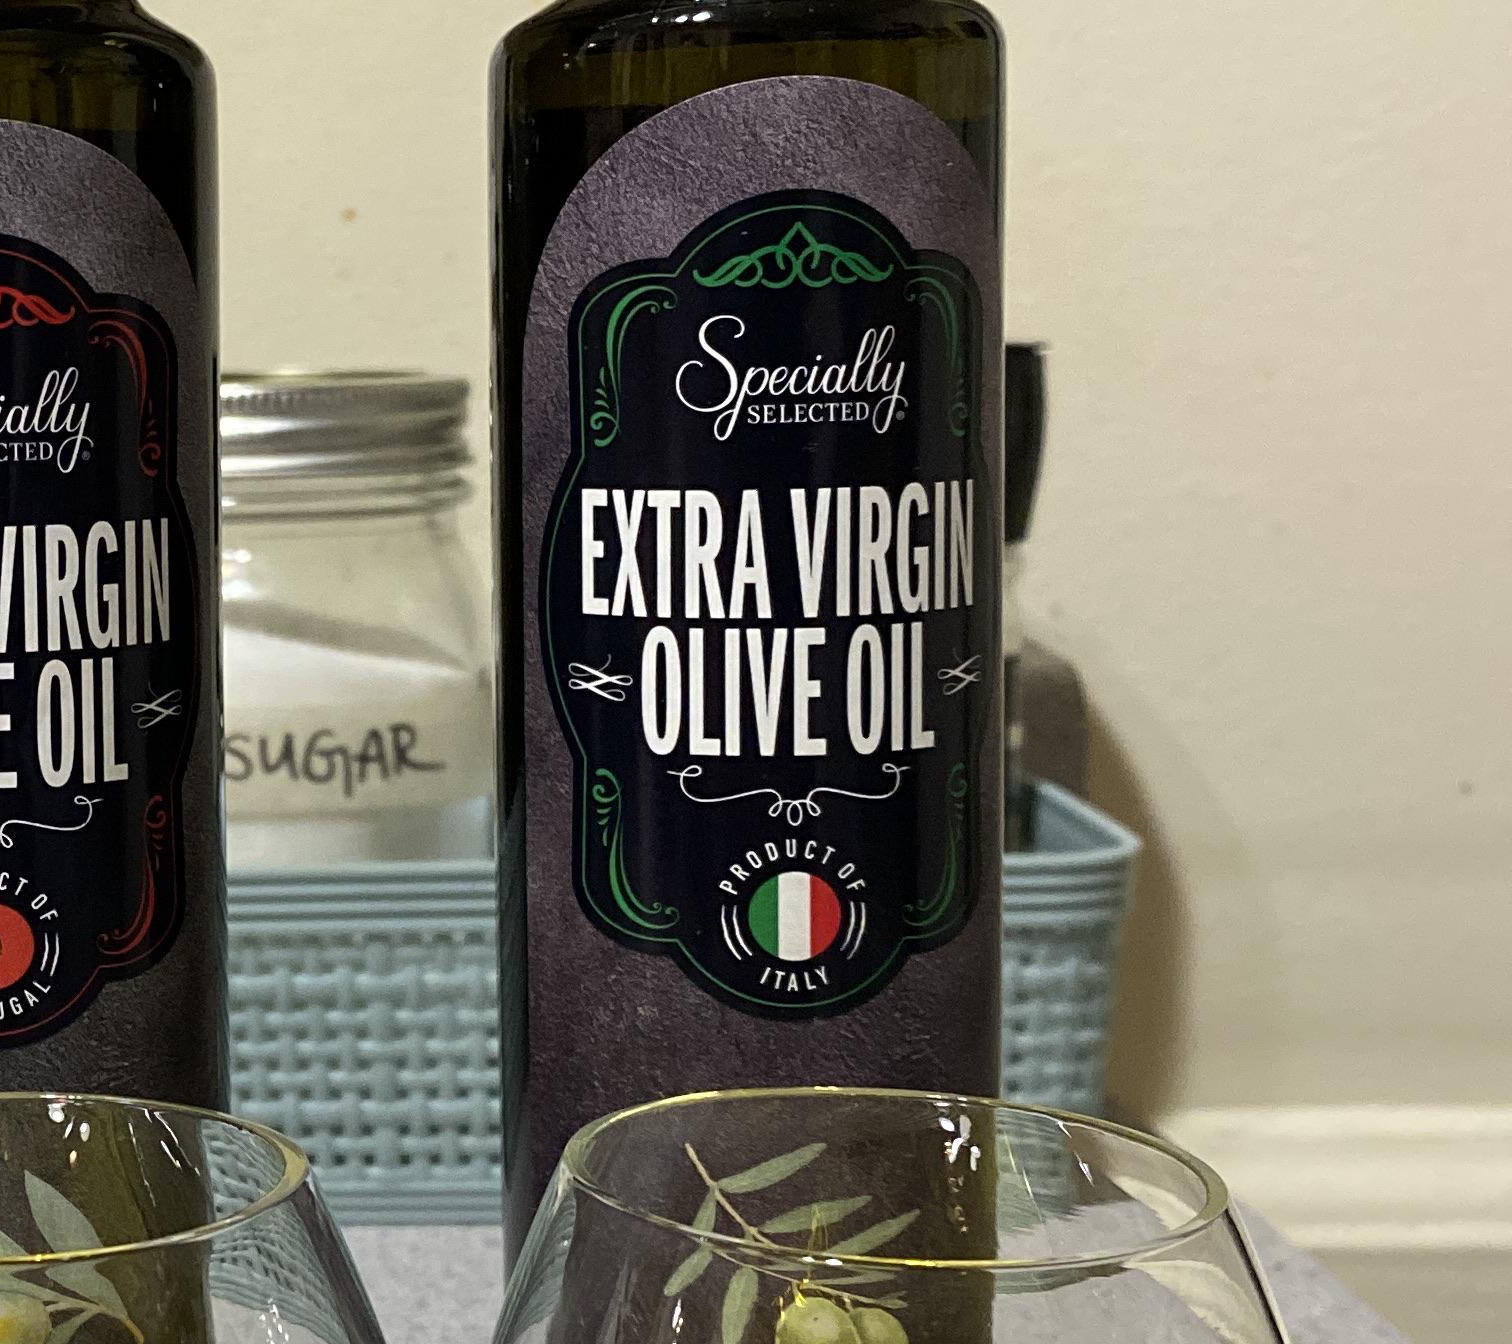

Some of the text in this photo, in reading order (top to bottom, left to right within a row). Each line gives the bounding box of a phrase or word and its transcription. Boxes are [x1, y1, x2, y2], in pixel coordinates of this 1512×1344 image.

[676, 314, 906, 441] Specially
[747, 402, 869, 424] SELECTED
[581, 479, 976, 620] EXTRA VIRGIN
[37, 656, 129, 788] OIL
[640, 621, 936, 757] OLIVE OIL
[223, 720, 447, 798] SUGAR
[719, 838, 866, 895] PRODUCT OF
[31, 893, 59, 922] OF
[759, 965, 830, 992] ITALY
